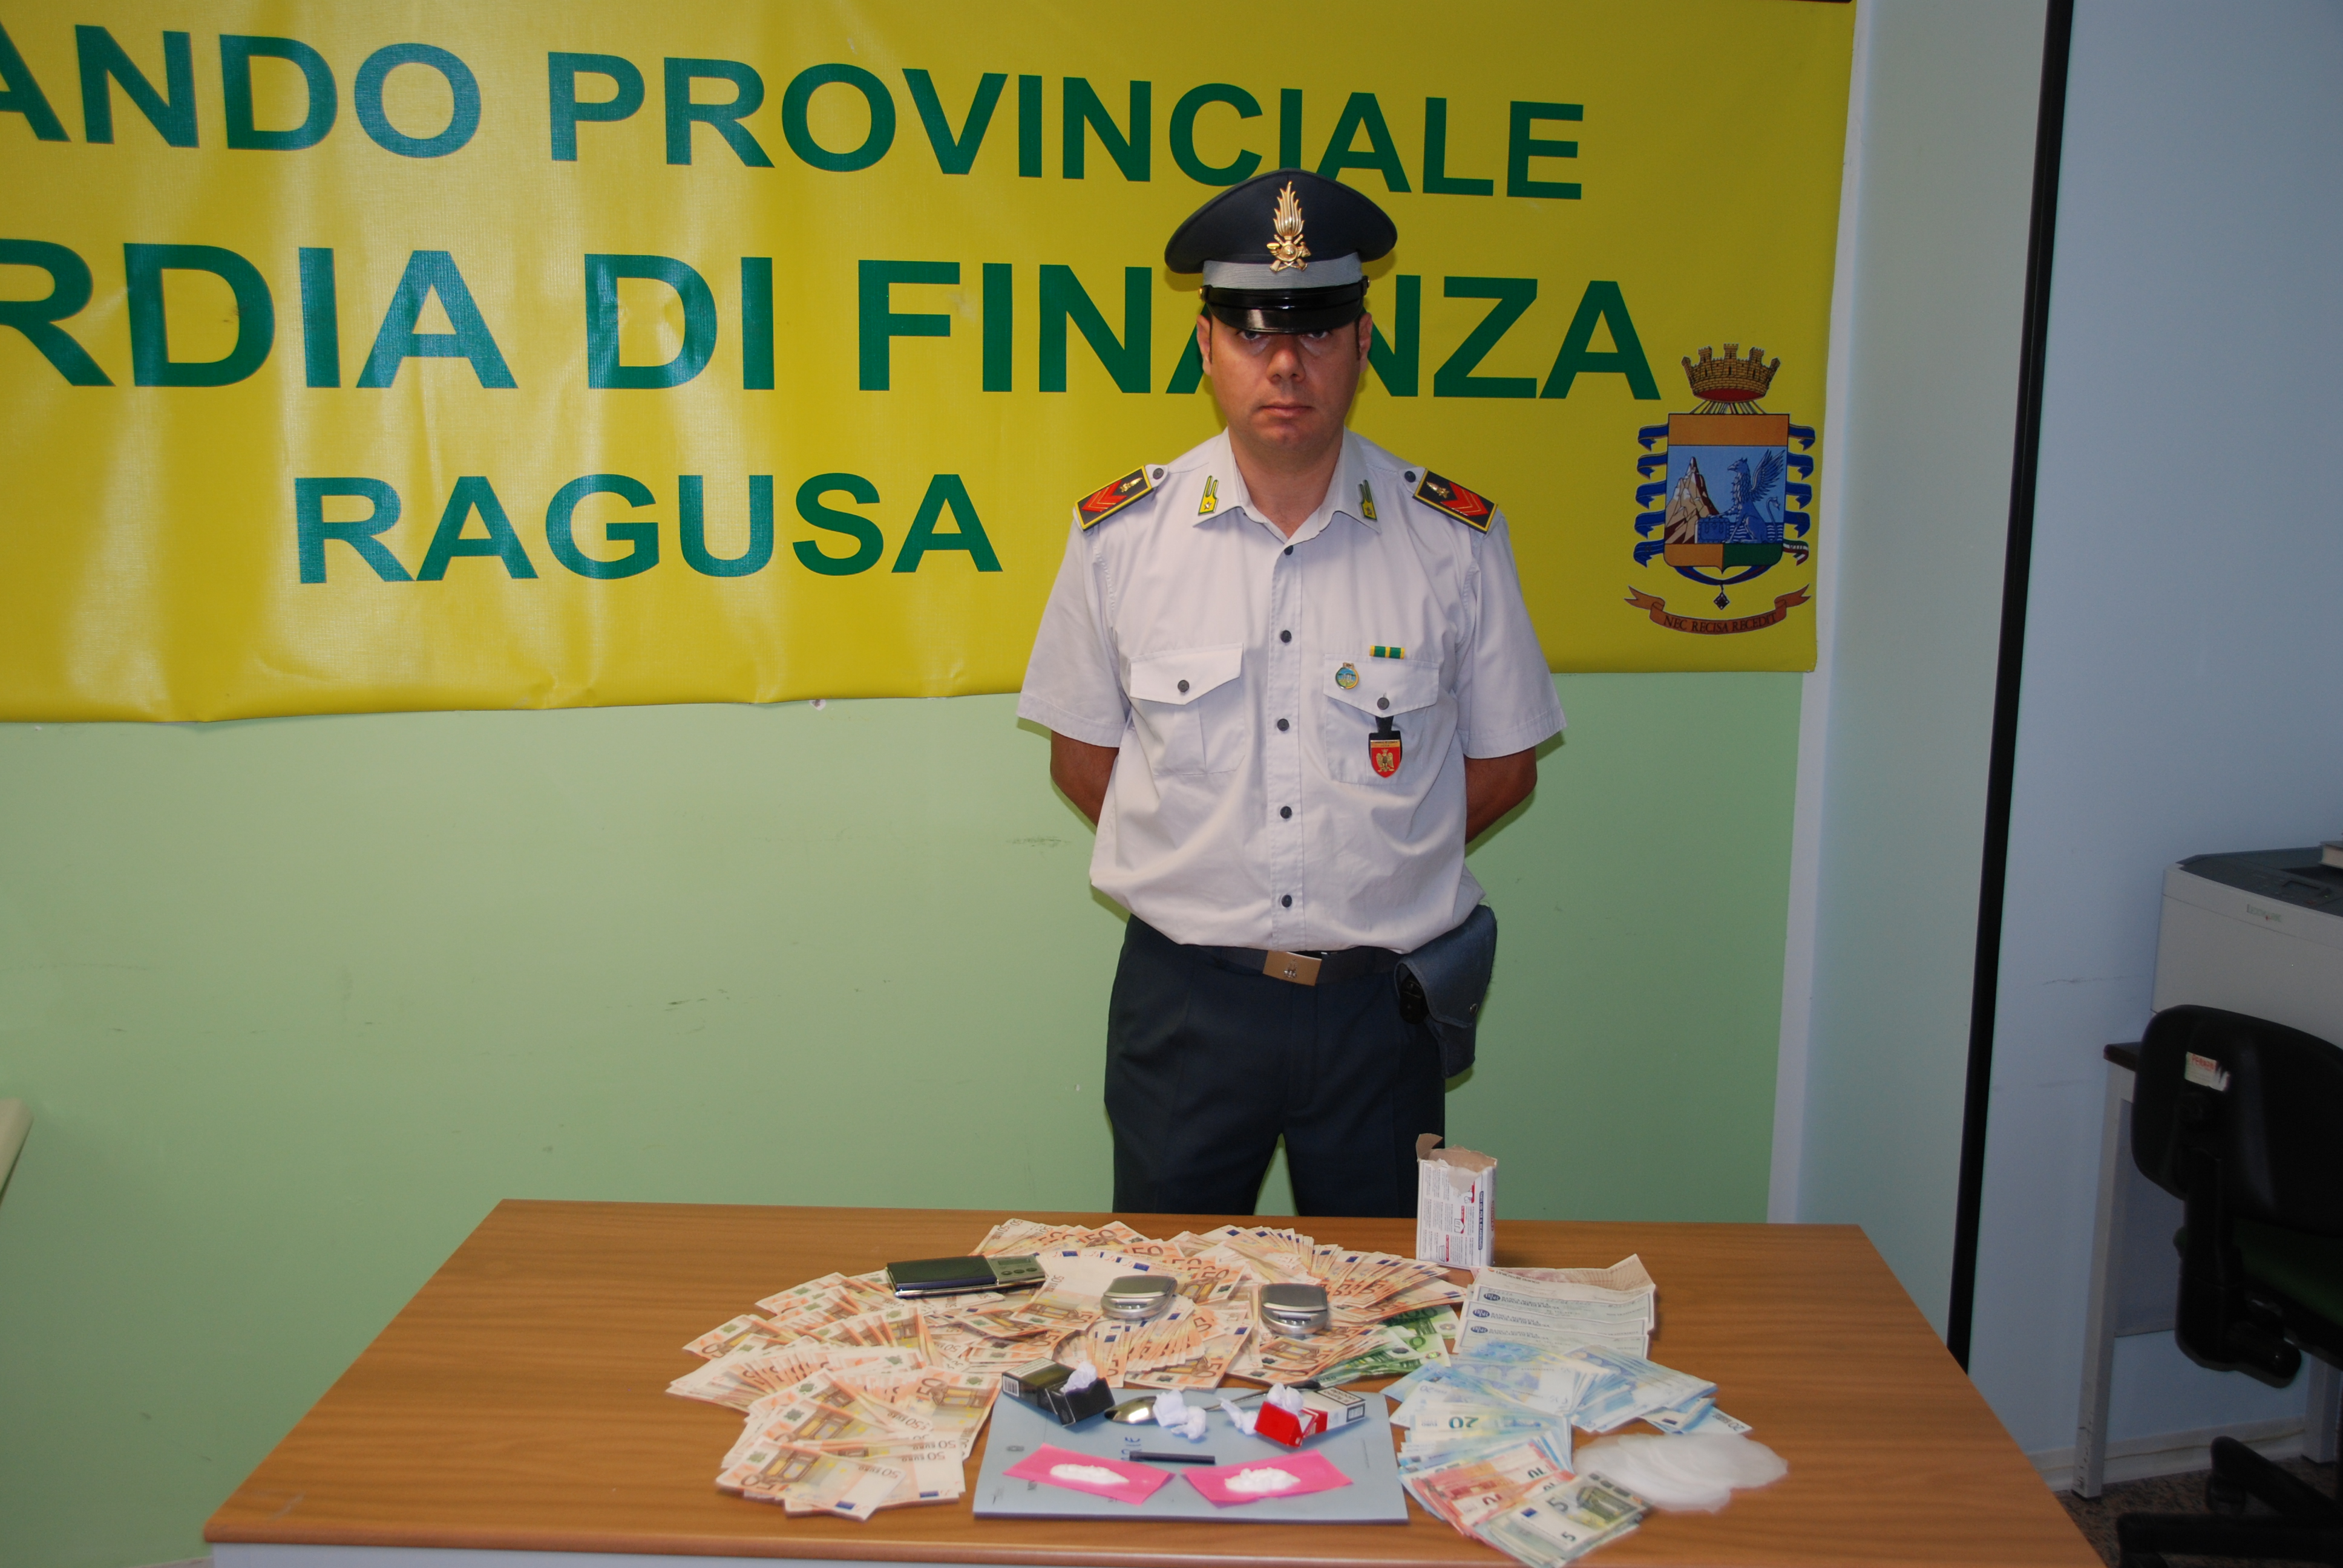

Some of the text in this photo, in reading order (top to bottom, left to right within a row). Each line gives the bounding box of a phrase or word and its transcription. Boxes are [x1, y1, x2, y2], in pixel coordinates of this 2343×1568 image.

[549, 52, 1583, 198] PROVINCIALE
[585, 254, 774, 389] DI
[859, 260, 1660, 399] FINNZA
[295, 474, 1001, 583] RAGUSA
[1664, 612, 1777, 633] NEC RECISA RECEDIT
[1448, 1416, 1478, 1429] 20
[1561, 1531, 1576, 1542] 5
